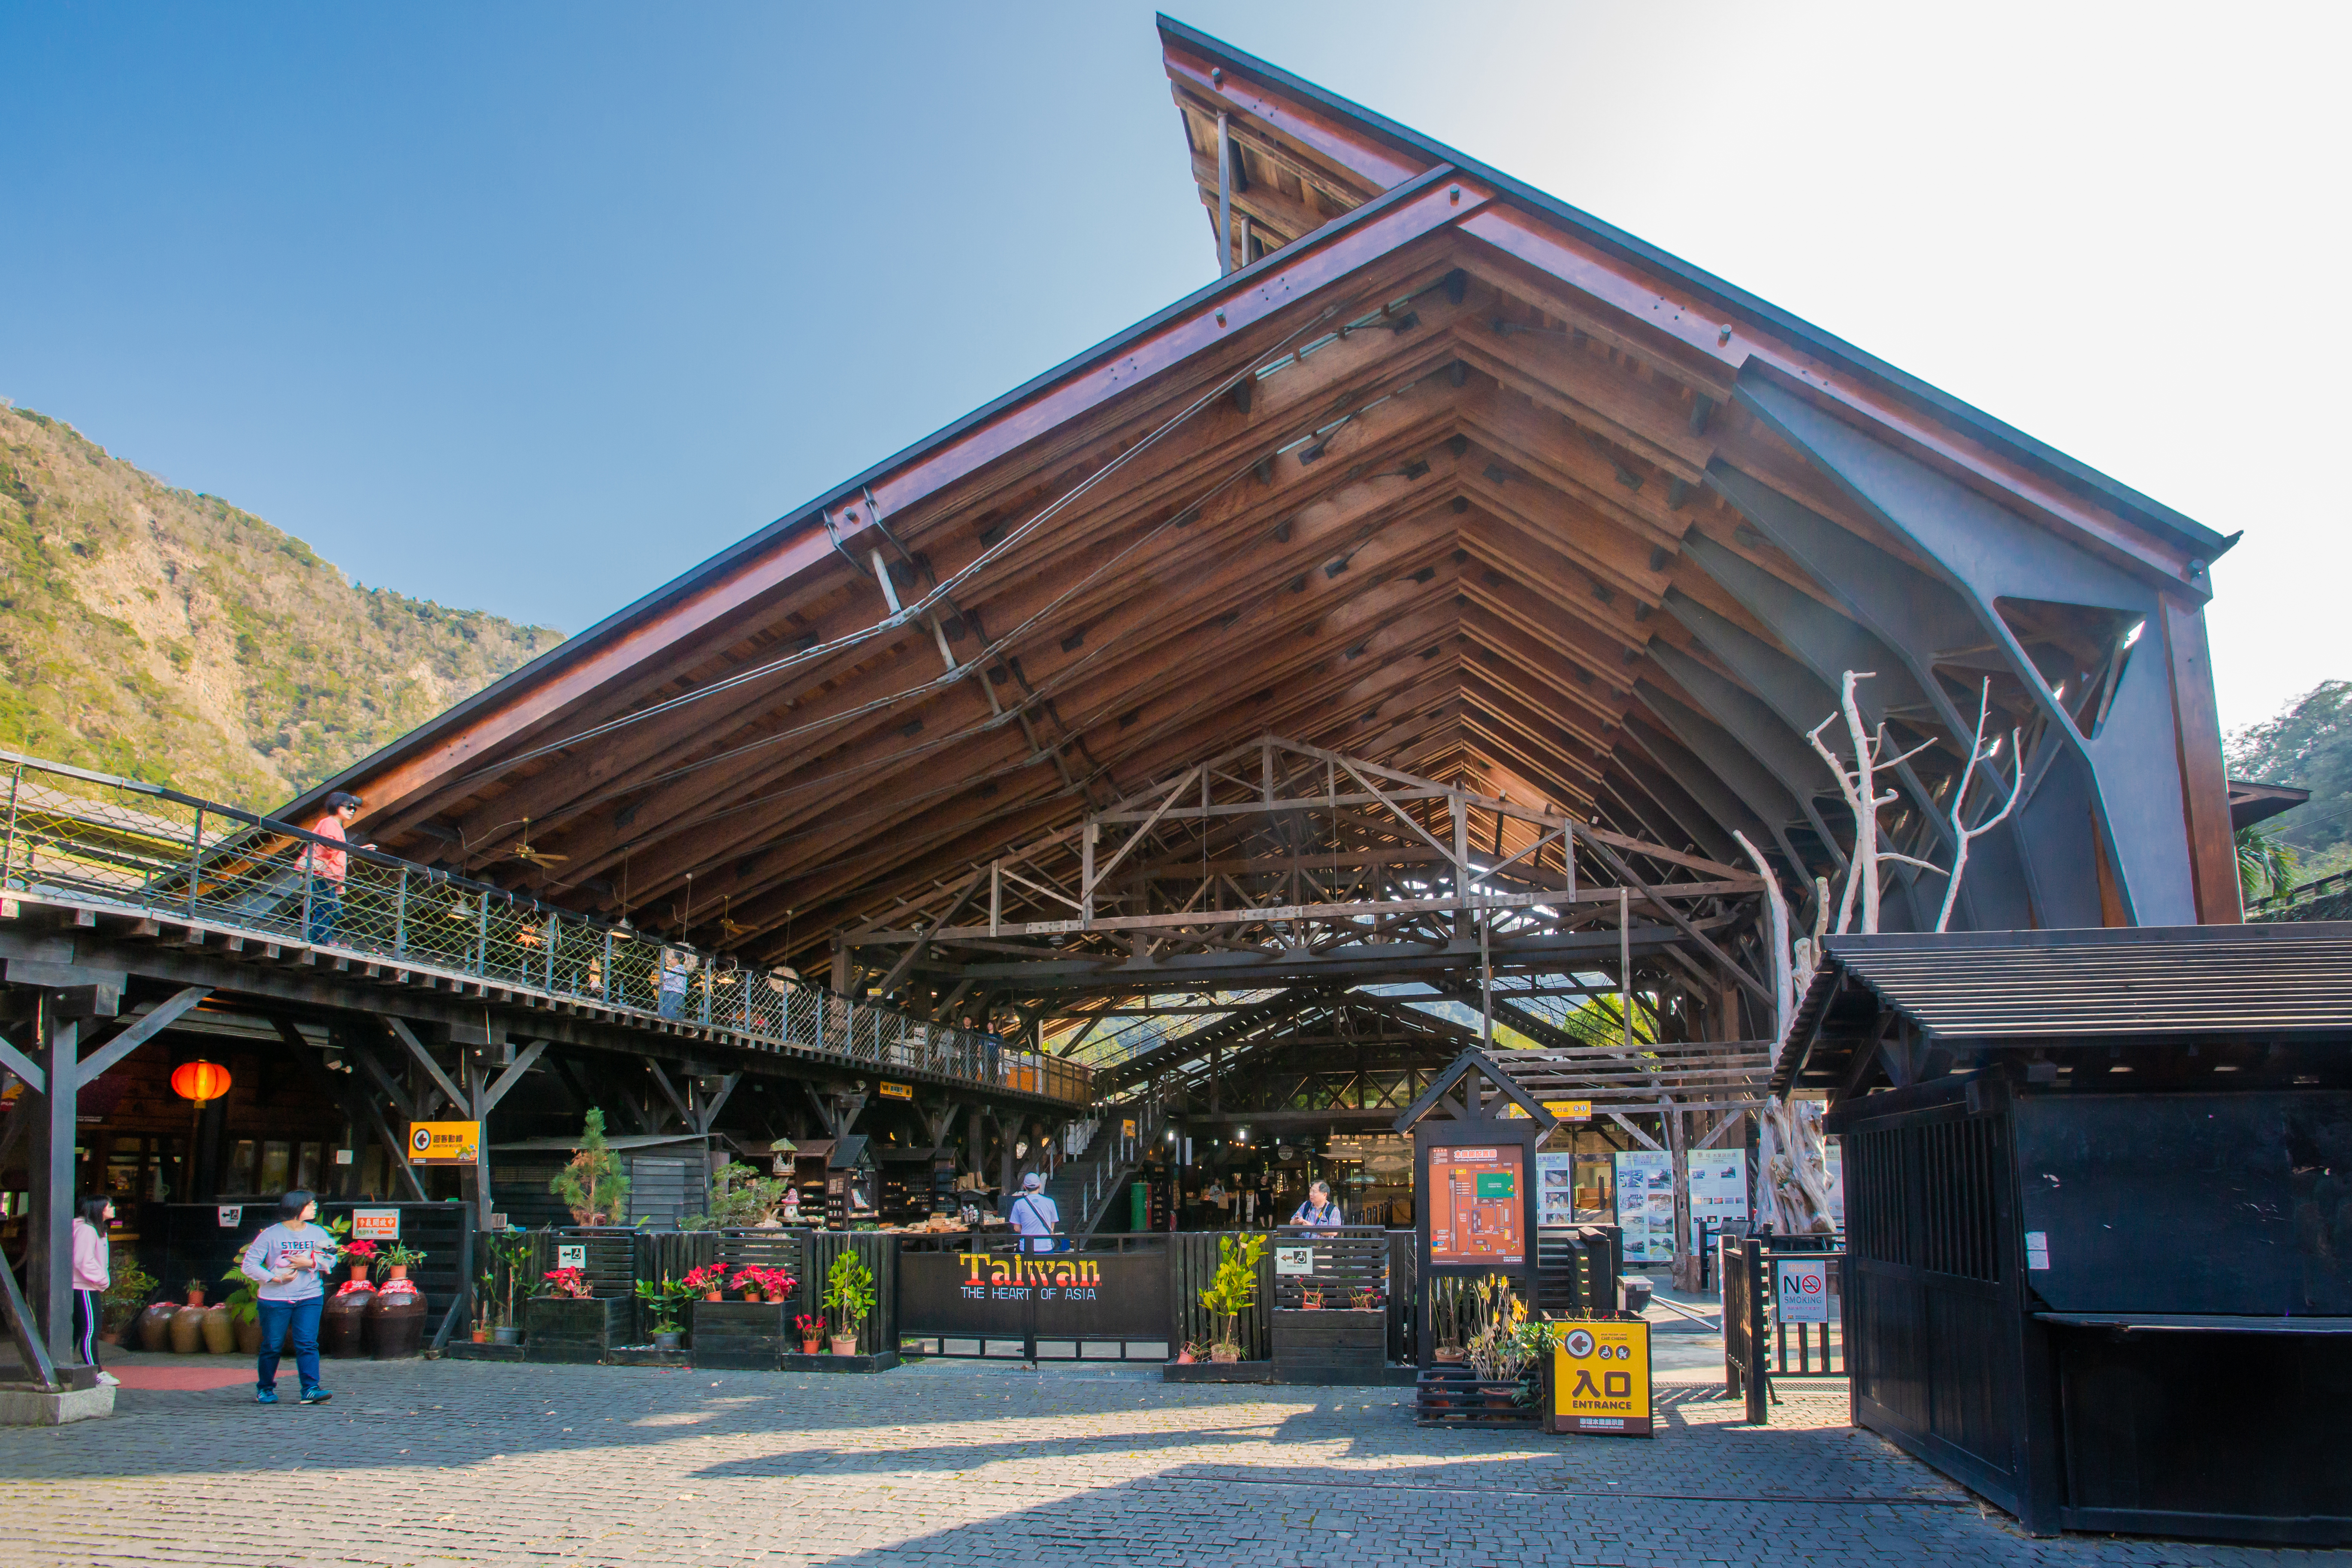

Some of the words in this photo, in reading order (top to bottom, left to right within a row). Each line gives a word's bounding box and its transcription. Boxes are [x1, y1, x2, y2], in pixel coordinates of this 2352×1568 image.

[360, 1218, 394, 1227] 冷氣開放中
[282, 1241, 315, 1249] STREET
[960, 1254, 1102, 1287] Taiwan
[961, 1287, 984, 1299] THE
[992, 1287, 1032, 1300] HEART
[1041, 1288, 1057, 1299] OF
[1065, 1288, 1096, 1300] ASIA
[1572, 1369, 1631, 1398] 入口
[1572, 1400, 1632, 1409] ENTRANCE
